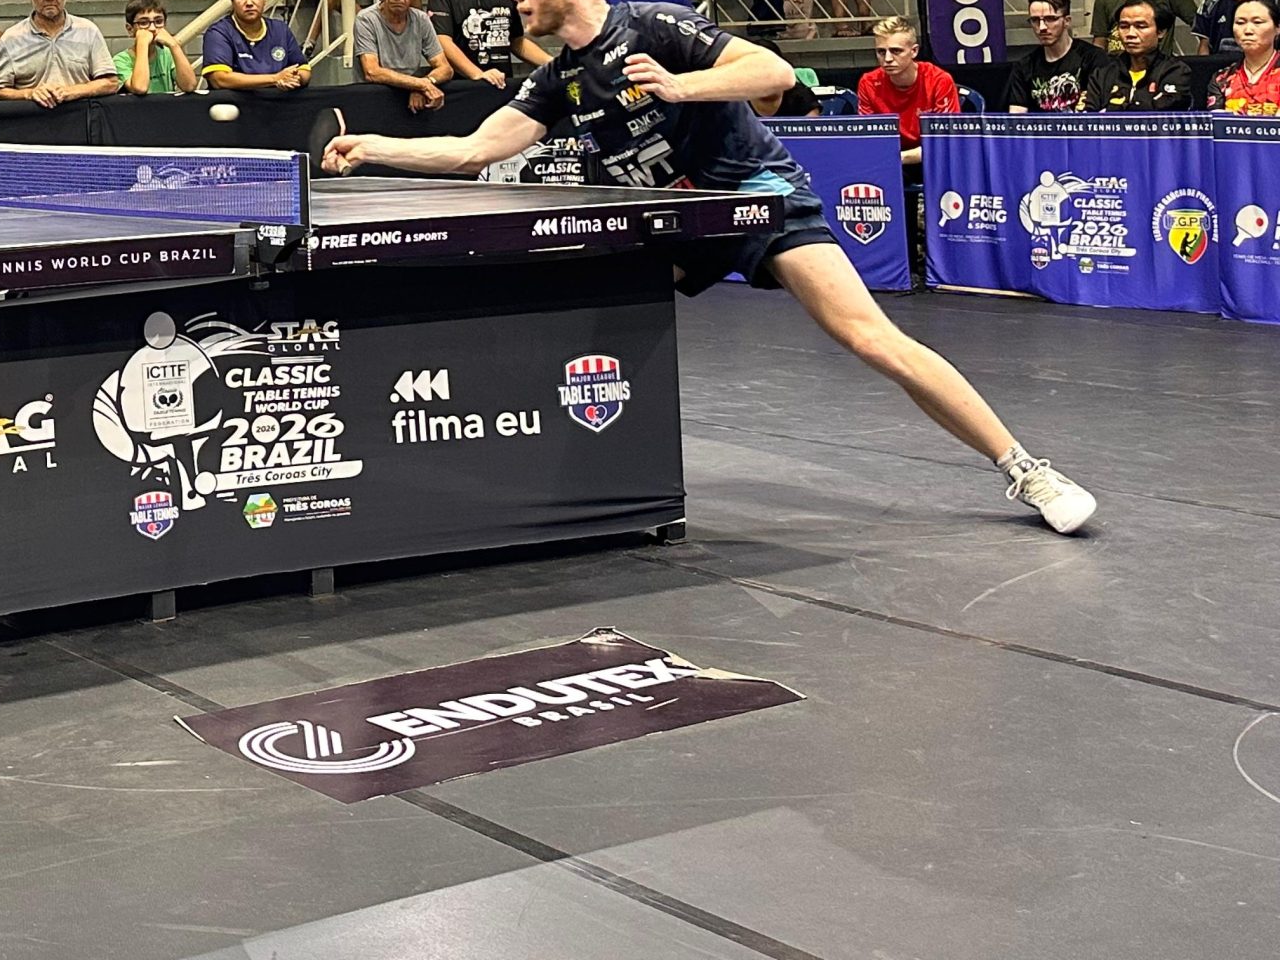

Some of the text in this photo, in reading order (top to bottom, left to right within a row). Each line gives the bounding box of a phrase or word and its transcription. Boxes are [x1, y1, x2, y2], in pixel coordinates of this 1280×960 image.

[603, 42, 628, 65] AVIS
[847, 124, 864, 132] CUP
[867, 124, 898, 132] BRAZIL
[1056, 123, 1084, 132] TABLE
[1088, 124, 1120, 132] TENNIS
[1125, 124, 1158, 132] WORLD
[1162, 123, 1181, 131] CUP
[1226, 126, 1251, 135] STAG
[534, 163, 581, 175] CLASSIC
[970, 194, 1004, 208] FREE
[1074, 197, 1123, 210] CLASSIC
[733, 205, 769, 219] STAG
[836, 206, 891, 222] TABLE TENNIS
[969, 209, 1007, 223] PONG
[560, 217, 628, 234] filma eu
[1071, 220, 1128, 236] 2026
[322, 231, 448, 249] FREE PONG SPORTS
[1070, 234, 1126, 248] BRAZIL
[51, 253, 113, 271] WORLD
[119, 250, 153, 266] CUP
[159, 247, 218, 262] BRAZIL
[267, 319, 340, 342] STAG
[267, 343, 341, 352] GLOBAL
[146, 364, 186, 379] ICTTF
[225, 364, 331, 388] CLASSIC
[571, 371, 616, 383] MAJOR LEAGUE
[243, 386, 340, 413] TABLE TENNIS
[558, 381, 631, 406] TABLE TENNIS
[255, 400, 329, 414] WORLD CUP
[222, 412, 345, 447] 2026
[255, 424, 276, 434] 2026
[392, 409, 541, 444] filma eu
[220, 439, 341, 473] BRAZIL
[236, 467, 333, 485] Três Coroas City
[283, 498, 351, 513] TRÊS COROAS
[130, 507, 179, 525] TABLE TENNIS
[365, 655, 698, 736] ENDUTEX
[512, 692, 653, 730] BRASIL
